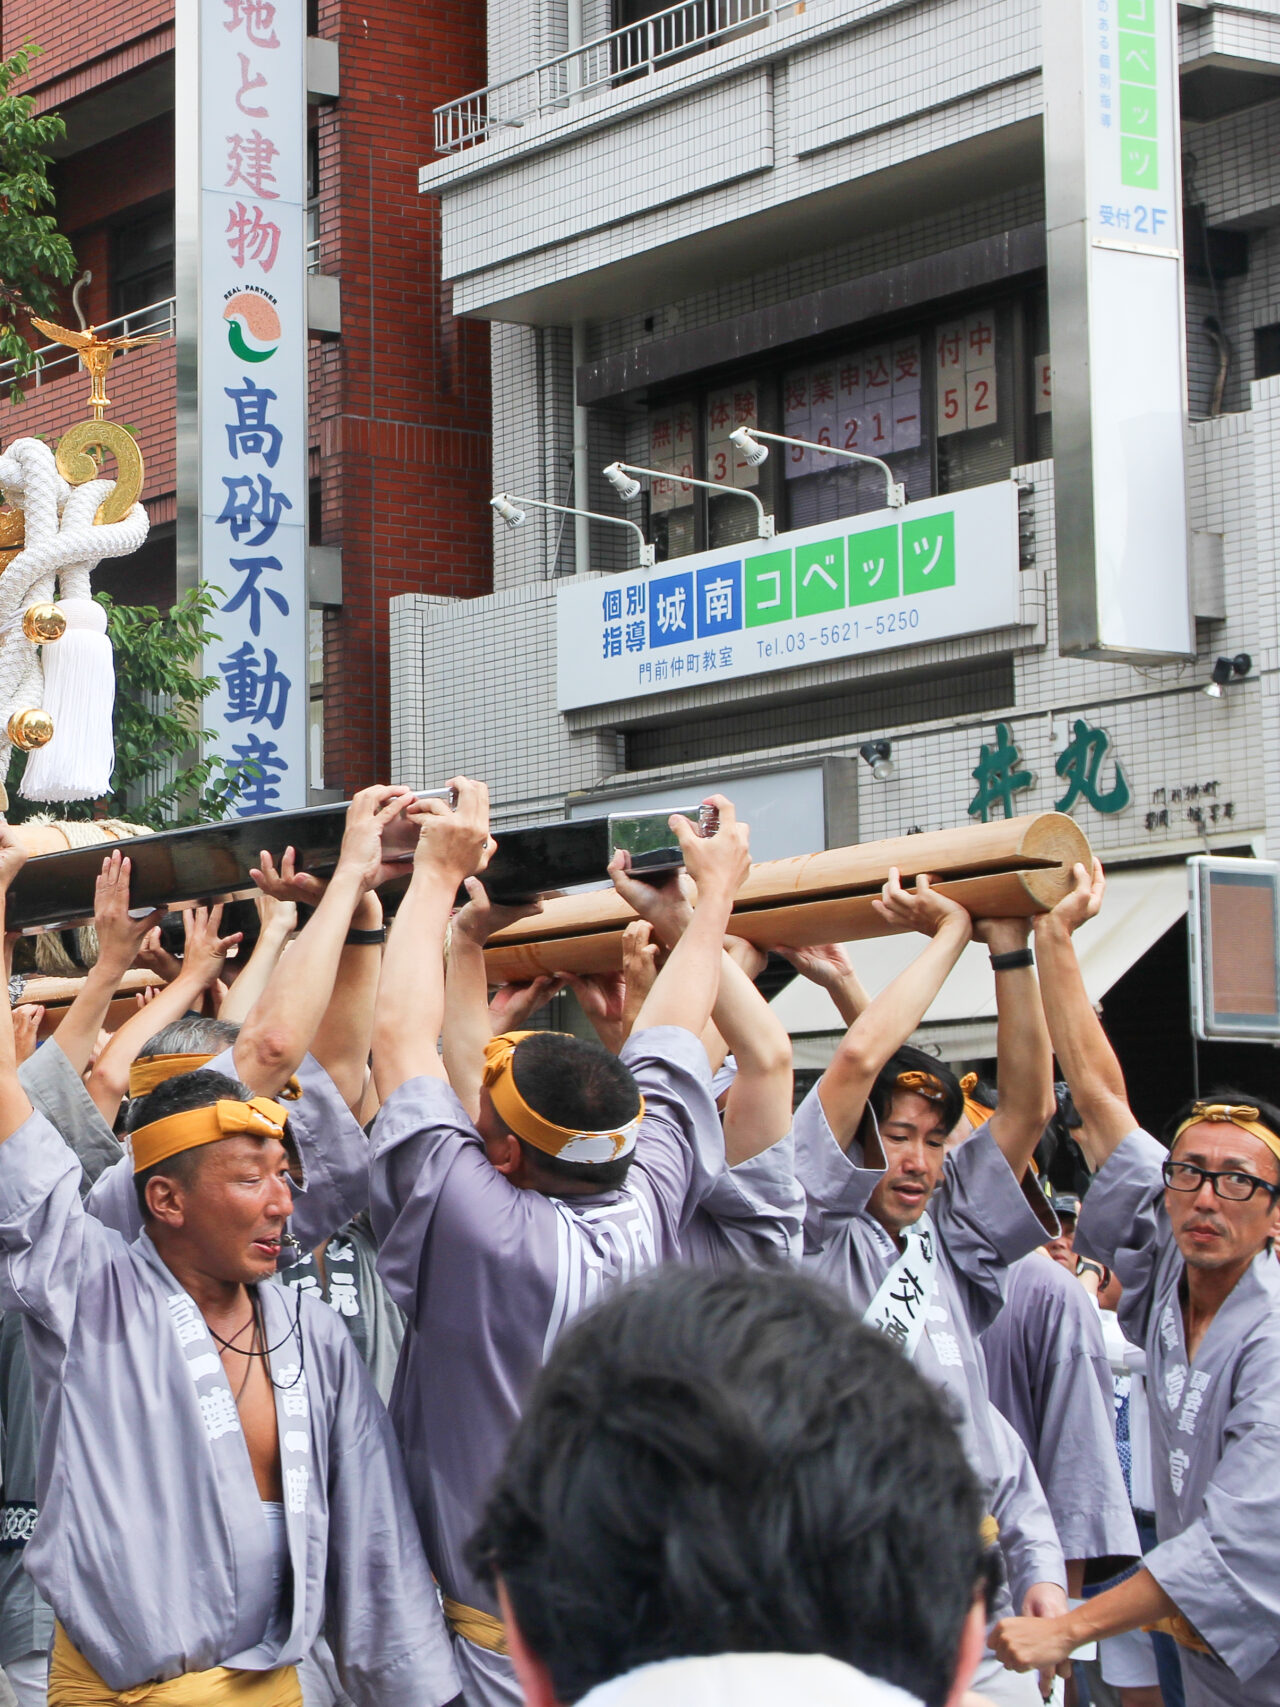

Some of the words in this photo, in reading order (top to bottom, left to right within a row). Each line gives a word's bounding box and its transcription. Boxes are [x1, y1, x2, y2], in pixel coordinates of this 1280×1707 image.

[222, 0, 282, 274] 地と建物
[1099, 204, 1168, 235] 受付2F
[223, 286, 242, 301] REAL
[245, 284, 278, 305] PARTNER
[602, 581, 646, 622] 個別
[602, 621, 646, 659] 指導
[757, 609, 919, 659] Tel.03-5621-5250
[639, 646, 734, 684] 門前仲町教室
